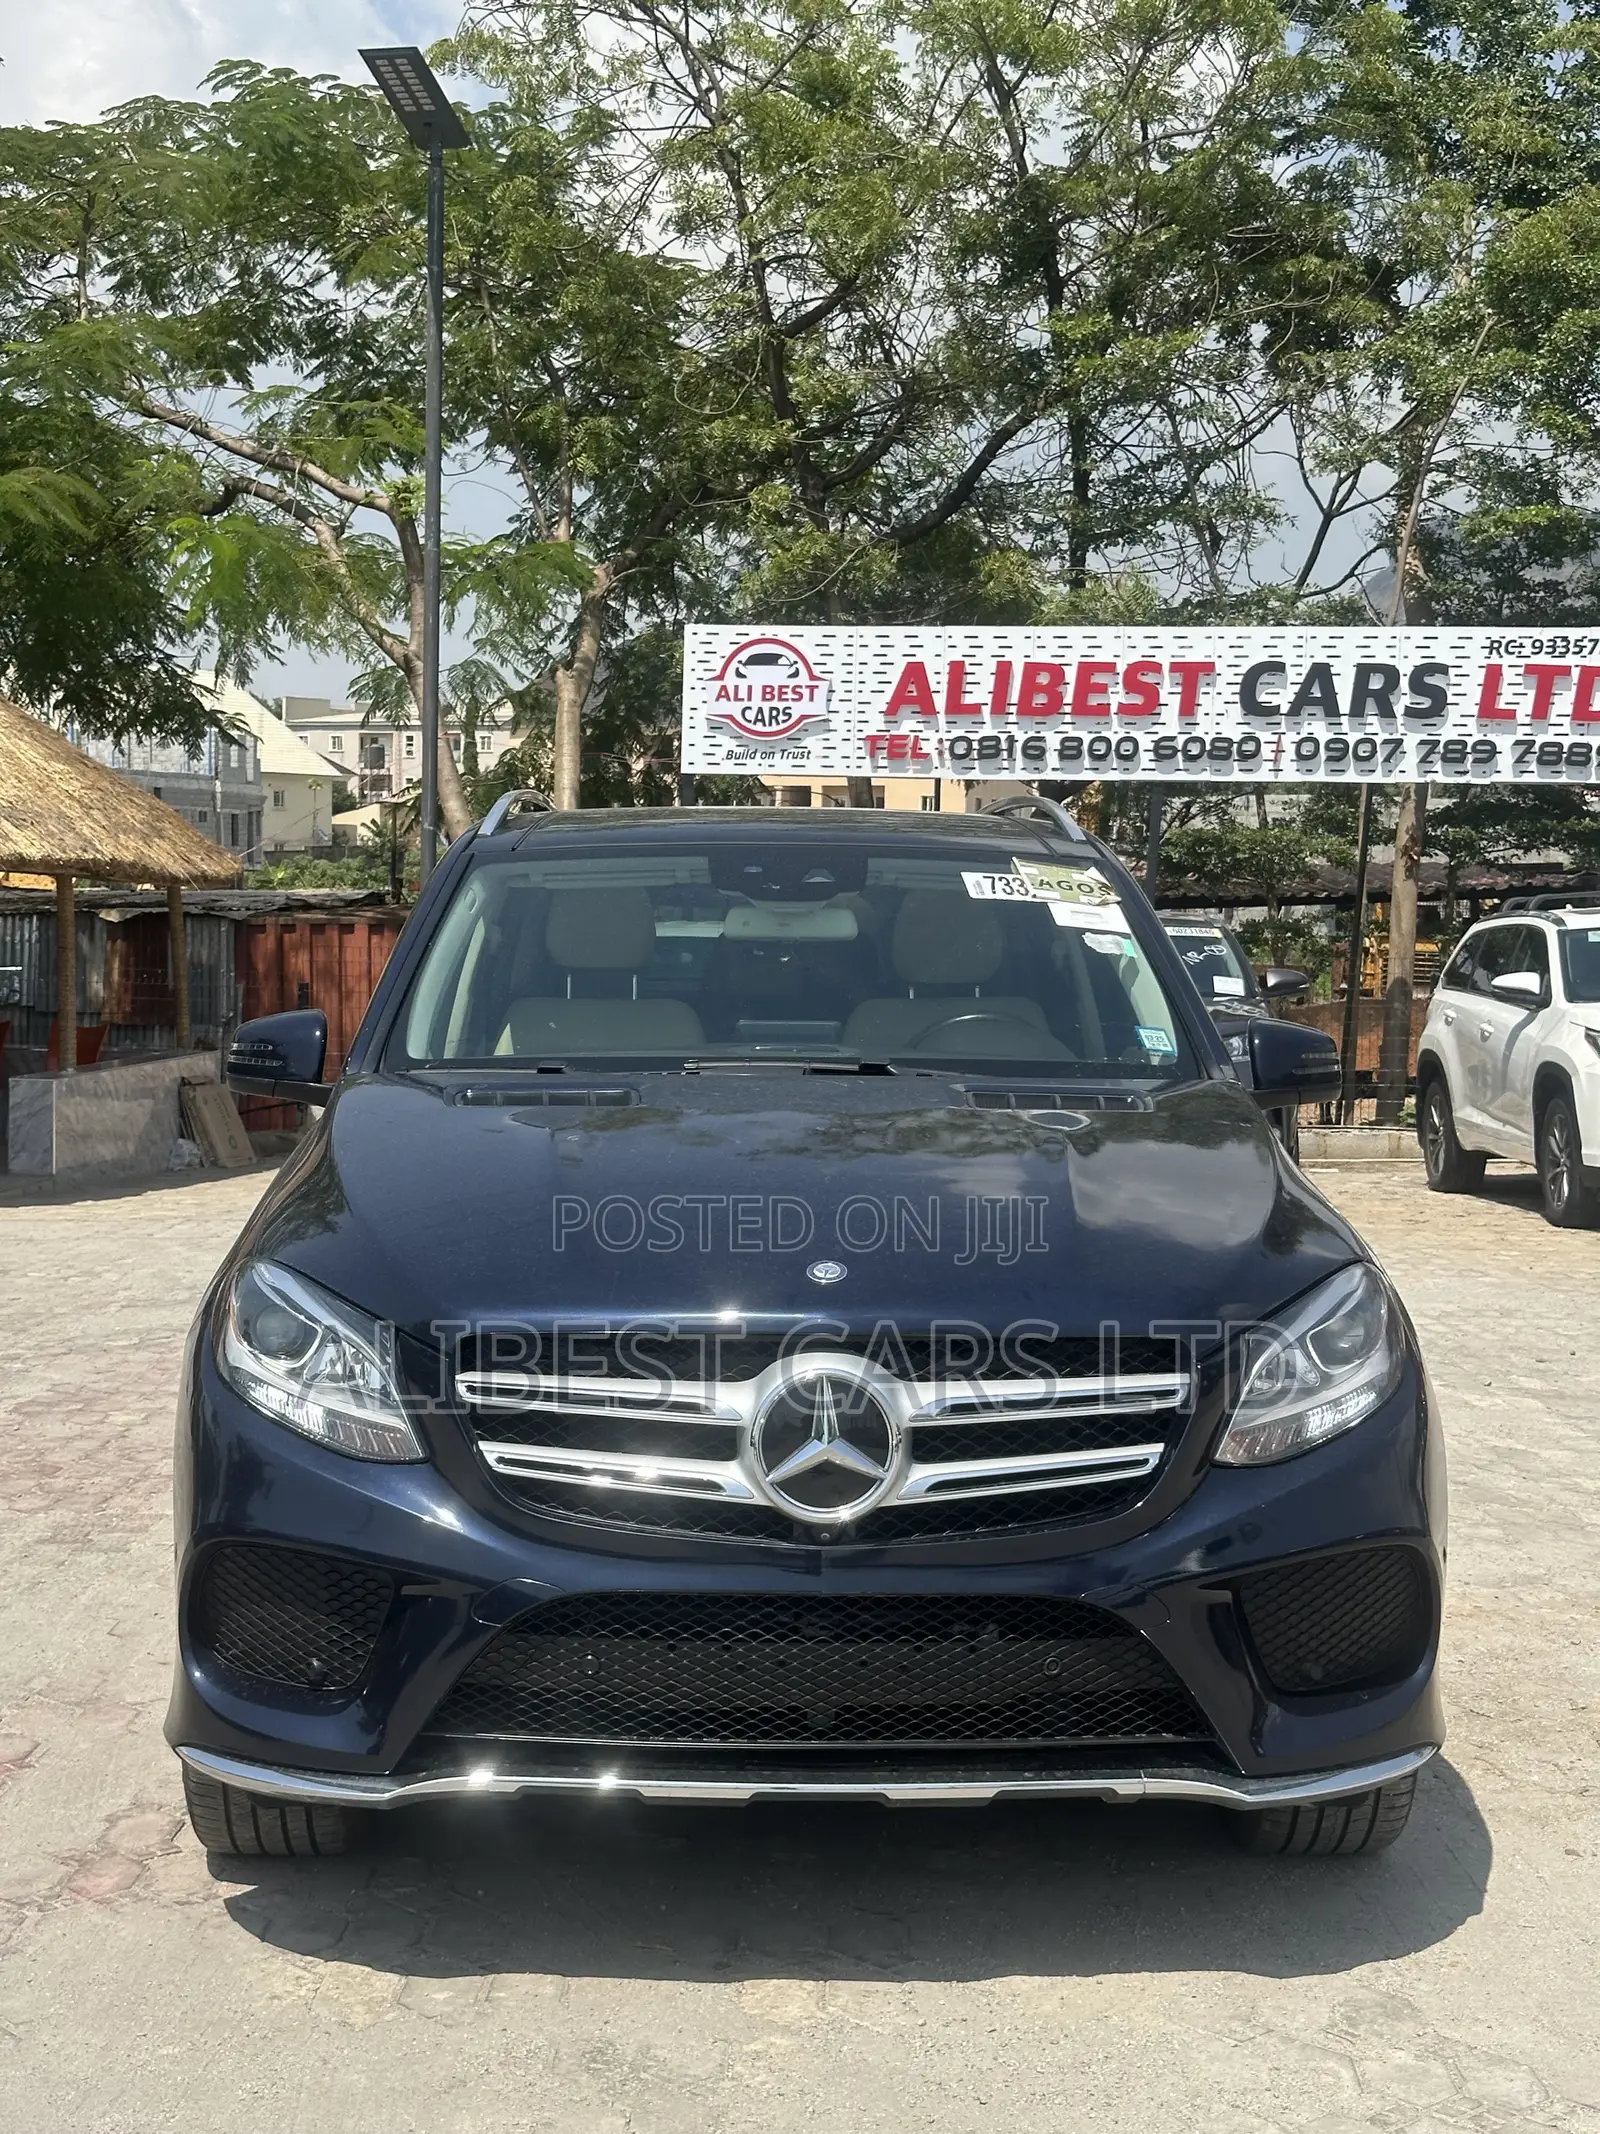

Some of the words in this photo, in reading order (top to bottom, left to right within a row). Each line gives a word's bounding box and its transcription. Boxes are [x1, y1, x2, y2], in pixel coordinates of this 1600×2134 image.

[714, 684, 753, 703] ALI
[761, 684, 819, 703] BEST
[883, 660, 1216, 717] ALIBEST
[1238, 660, 1451, 719] CARS
[740, 706, 793, 728] CARS
[725, 749, 758, 761] Build
[760, 751, 776, 761] on
[780, 749, 812, 761] Trust
[948, 734, 1046, 761] 0816
[1058, 735, 1139, 761] 800
[1152, 735, 1262, 762] 6080
[1295, 736, 1405, 763] 0907
[1415, 738, 1498, 765] 789
[1031, 878, 1114, 897] AGOS
